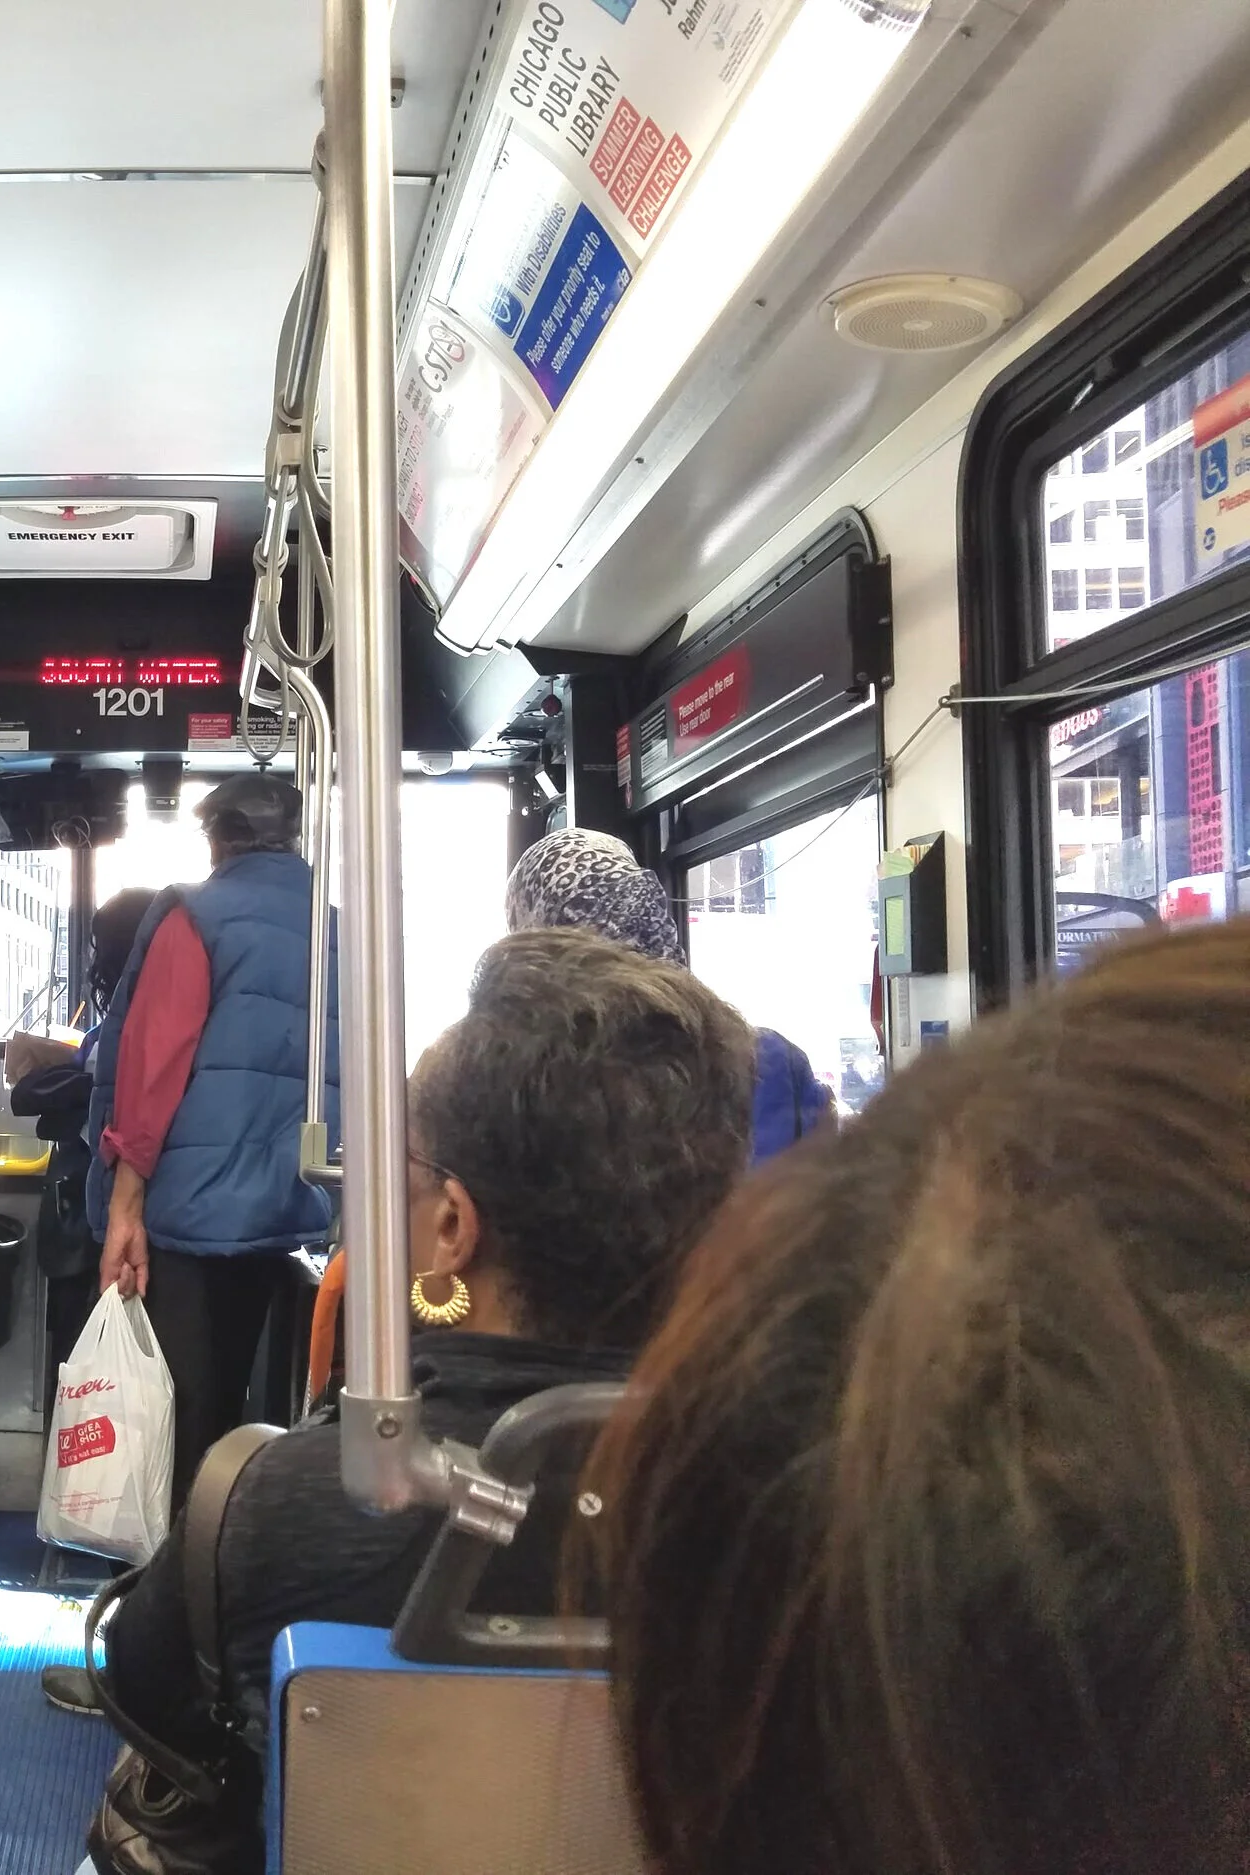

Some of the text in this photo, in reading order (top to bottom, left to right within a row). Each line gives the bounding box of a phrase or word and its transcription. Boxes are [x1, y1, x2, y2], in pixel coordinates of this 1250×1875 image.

[509, 2, 565, 108] CHICAGO
[538, 47, 587, 132] PUBLIC
[565, 56, 620, 158] LIBRARY
[594, 106, 637, 182] SUMMER
[612, 126, 661, 209] LEARNING
[632, 141, 690, 240] CHALLENGE
[515, 264, 538, 297] With
[530, 202, 567, 271] Disabilities
[617, 268, 631, 290] cta
[526, 231, 601, 369] Please offer your priority seat to
[550, 274, 606, 375] someone who needs it.
[7, 532, 135, 541] EMERGENCY EXIT
[42, 661, 220, 684] SOUTH WATER
[93, 688, 164, 716] 1201
[679, 672, 735, 720] Please move to the rear
[679, 707, 711, 737] Use rear door
